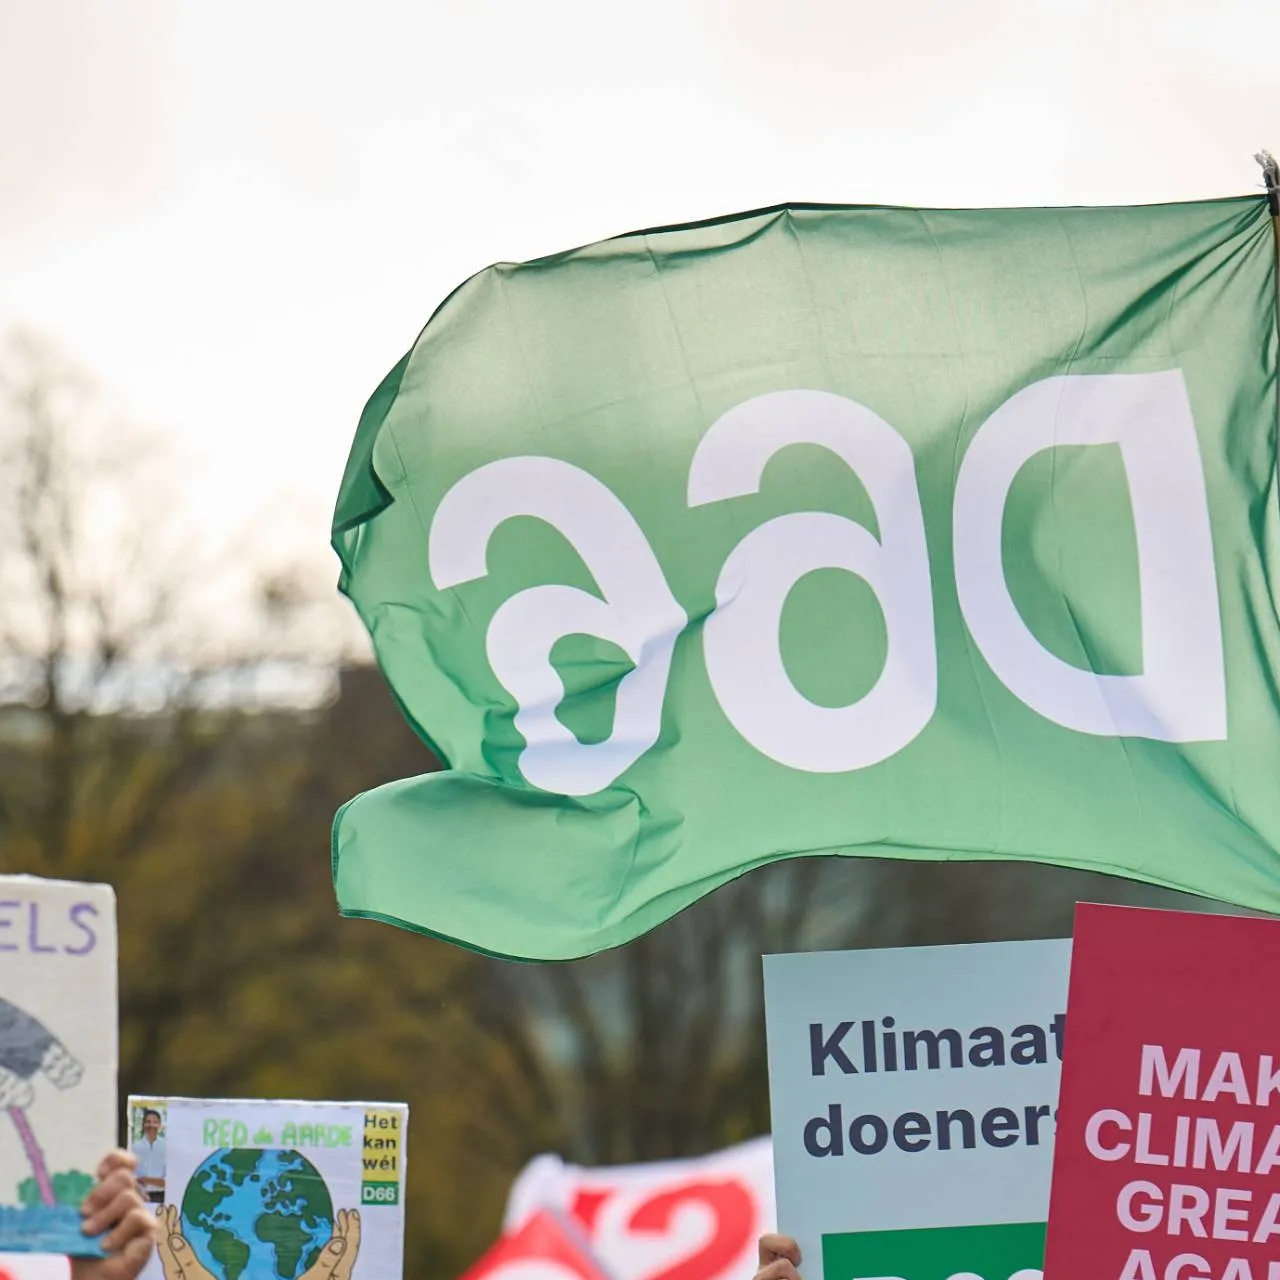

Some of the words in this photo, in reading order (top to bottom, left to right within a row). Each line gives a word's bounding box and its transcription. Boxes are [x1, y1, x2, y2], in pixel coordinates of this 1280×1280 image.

[809, 1014, 1066, 1076] Klimaat
[363, 1113, 398, 1129] Het
[803, 1103, 1058, 1157] doener
[202, 1118, 247, 1148] RED
[363, 1135, 398, 1150] kan
[362, 1153, 398, 1171] wél
[362, 1186, 396, 1201] D66
